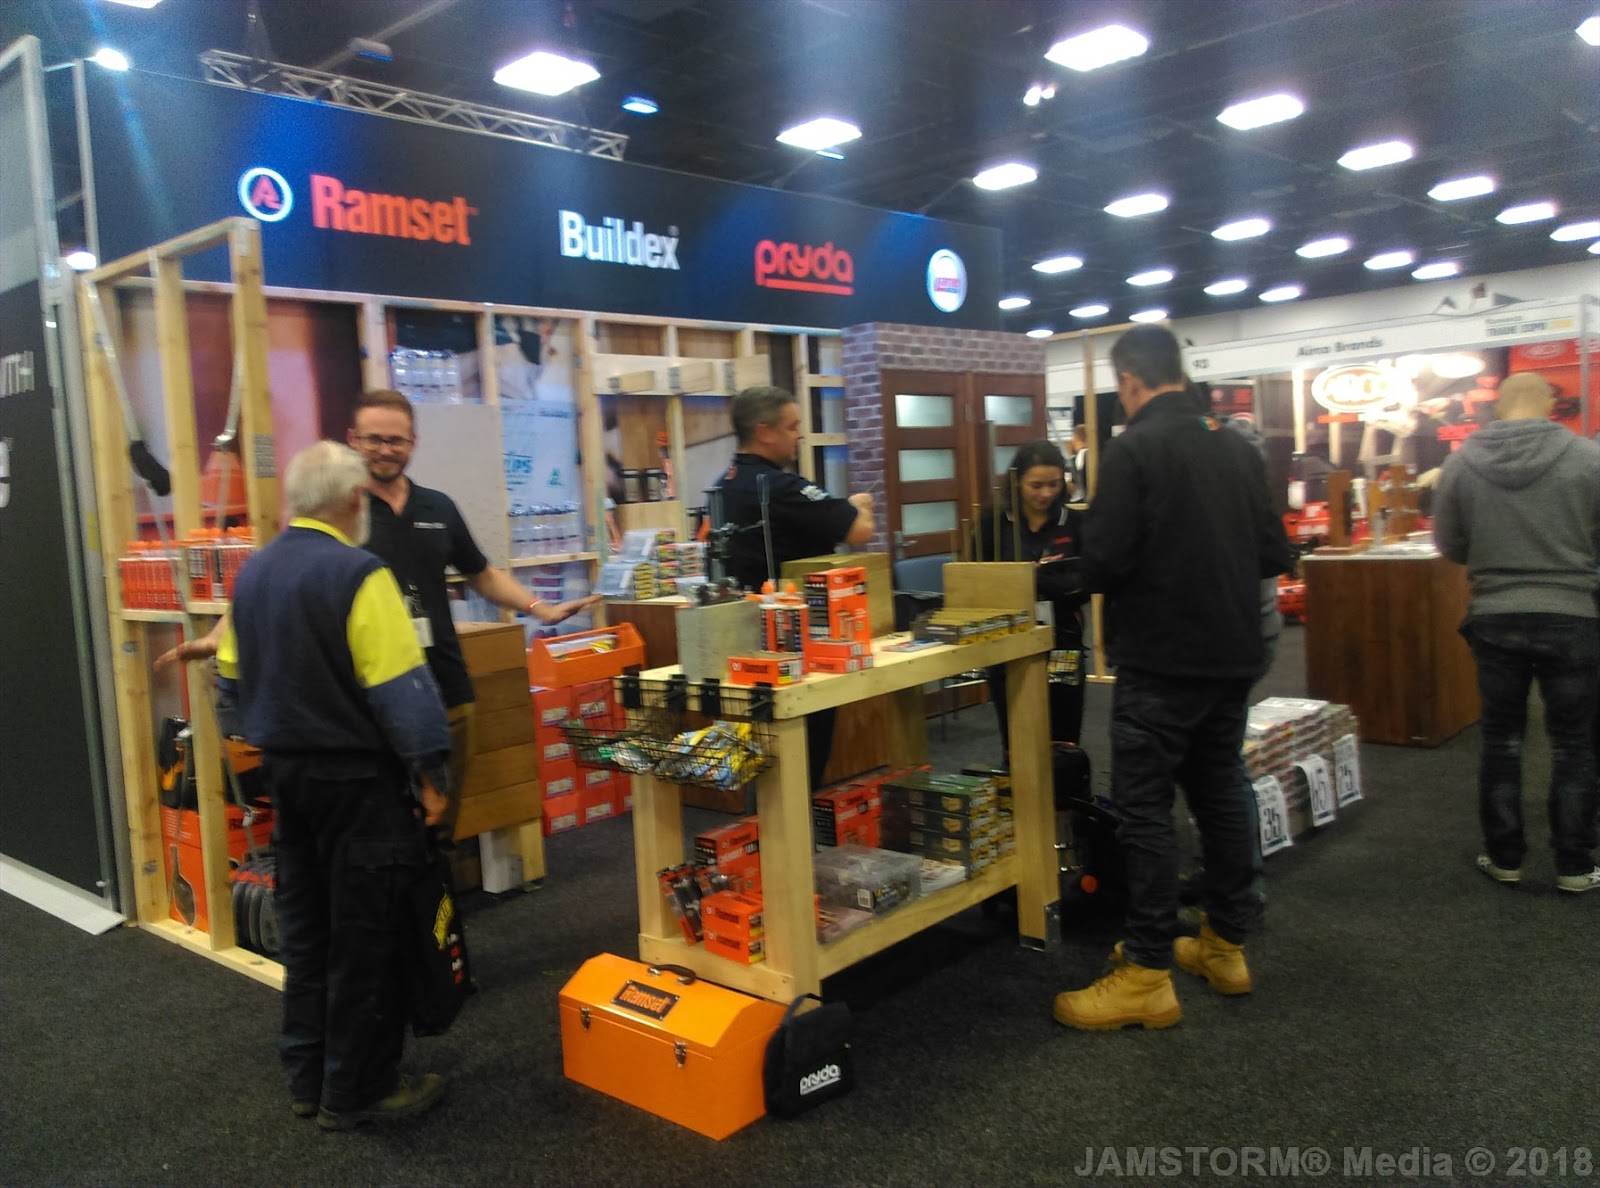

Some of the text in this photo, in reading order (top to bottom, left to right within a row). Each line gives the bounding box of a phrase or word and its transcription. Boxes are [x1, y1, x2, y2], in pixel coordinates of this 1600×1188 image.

[310, 174, 471, 246] Ramset
[558, 209, 681, 270] Buildex
[754, 239, 854, 288] pryda
[618, 984, 670, 1014] Ramset
[799, 1063, 842, 1096] pryda
